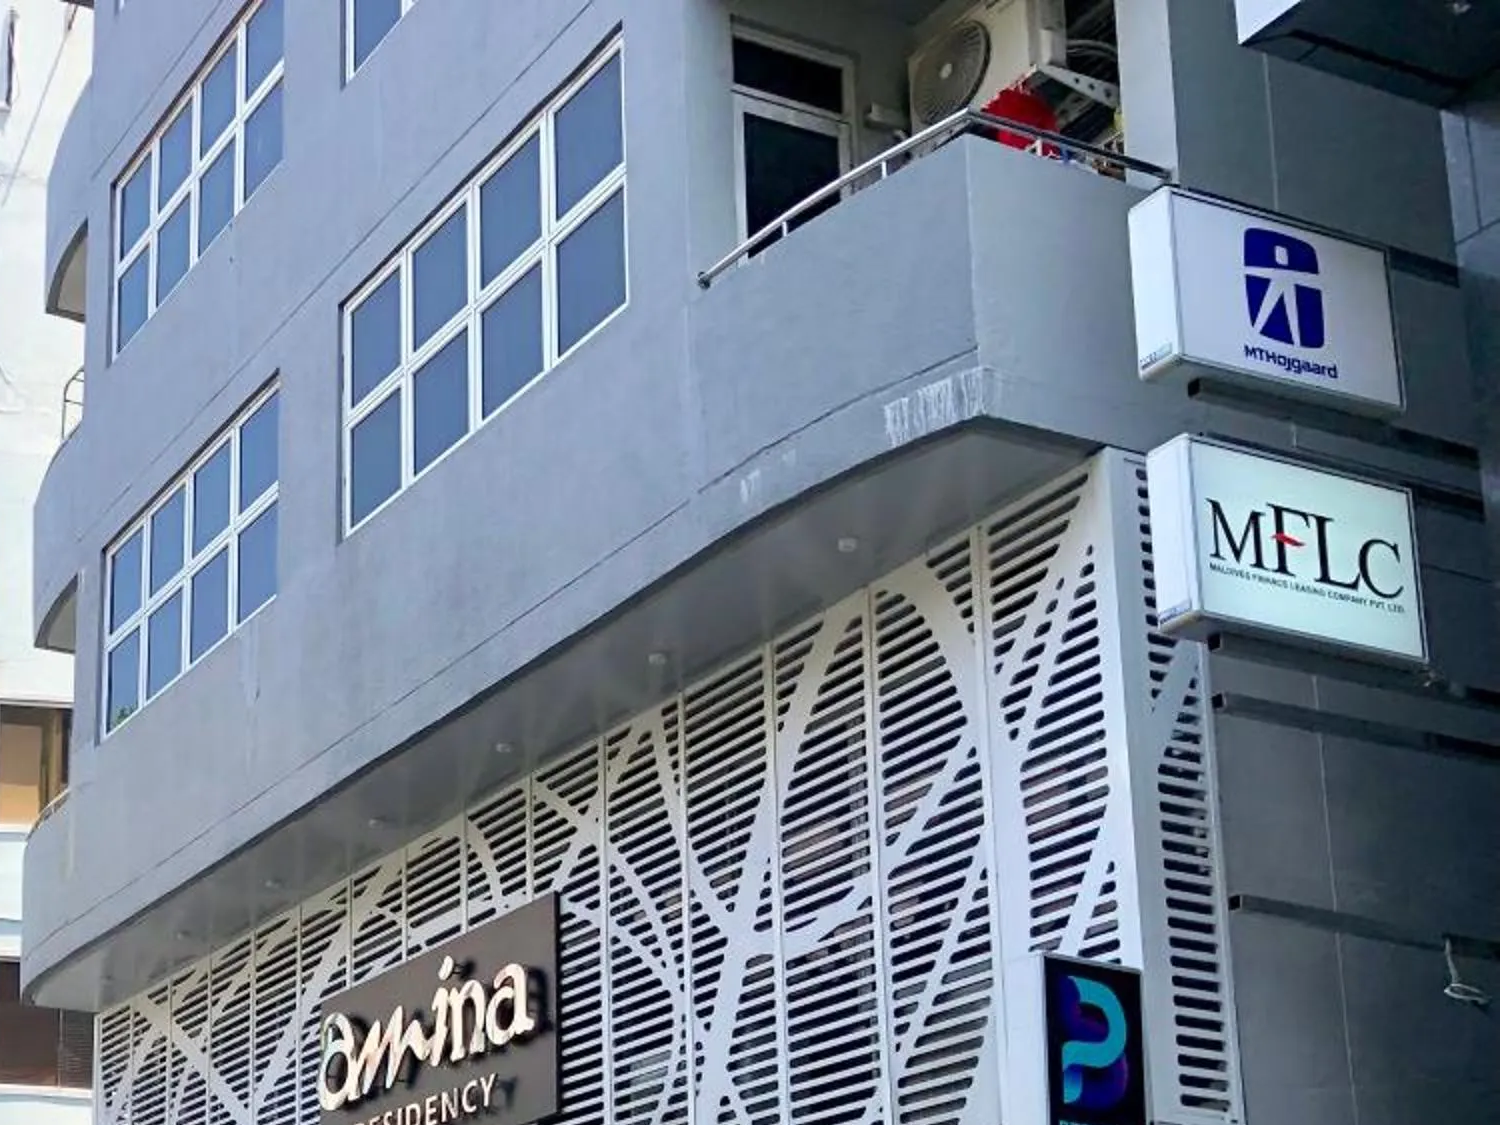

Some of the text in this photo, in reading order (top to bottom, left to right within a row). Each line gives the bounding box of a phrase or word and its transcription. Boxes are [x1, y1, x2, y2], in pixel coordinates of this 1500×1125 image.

[1205, 498, 1405, 600] MFLC
[1209, 562, 1250, 580] MALDIVES
[1290, 582, 1326, 597] LEASING
[1328, 591, 1367, 606] COMPANY
